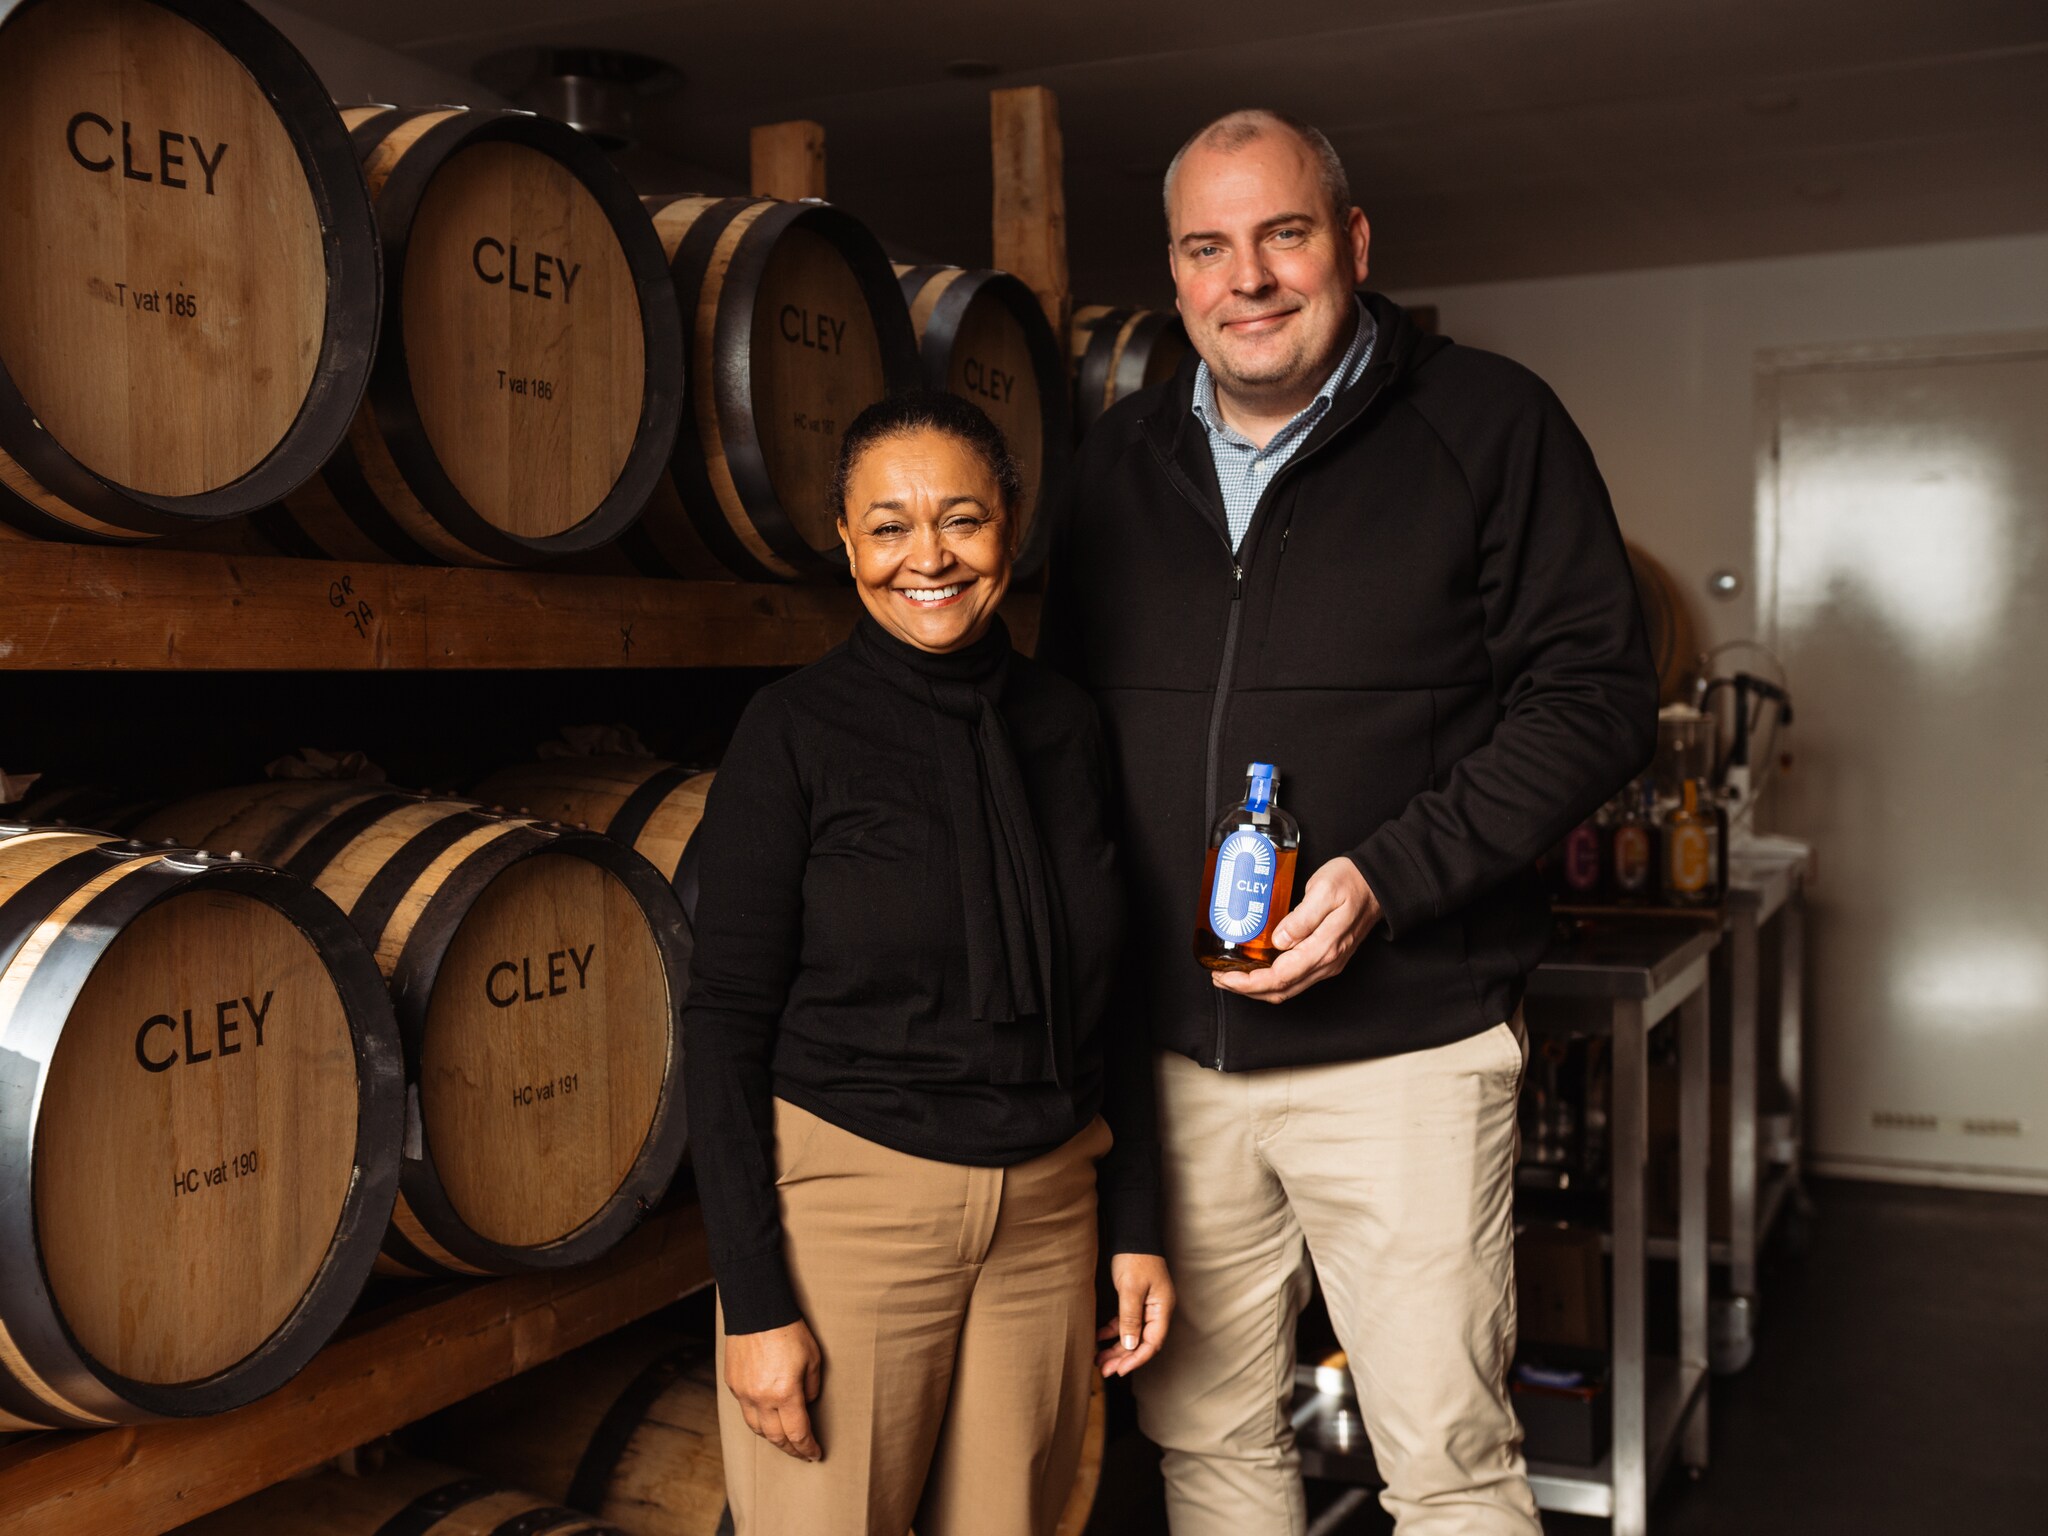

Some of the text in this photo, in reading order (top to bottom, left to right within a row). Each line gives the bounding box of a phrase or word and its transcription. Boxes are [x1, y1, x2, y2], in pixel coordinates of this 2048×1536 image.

[66, 111, 229, 196] CLEY
[472, 236, 582, 305] CLEY
[114, 282, 197, 318] T vat 185
[780, 303, 847, 356] CLEY
[497, 369, 553, 400] T vat 186
[963, 357, 1016, 405] CLEY
[1236, 879, 1268, 895] CLEY
[485, 943, 596, 1009] CLEY
[134, 990, 275, 1074] CLEY
[513, 1073, 578, 1109] HC vat 191
[173, 1150, 258, 1198] HC vat 190
